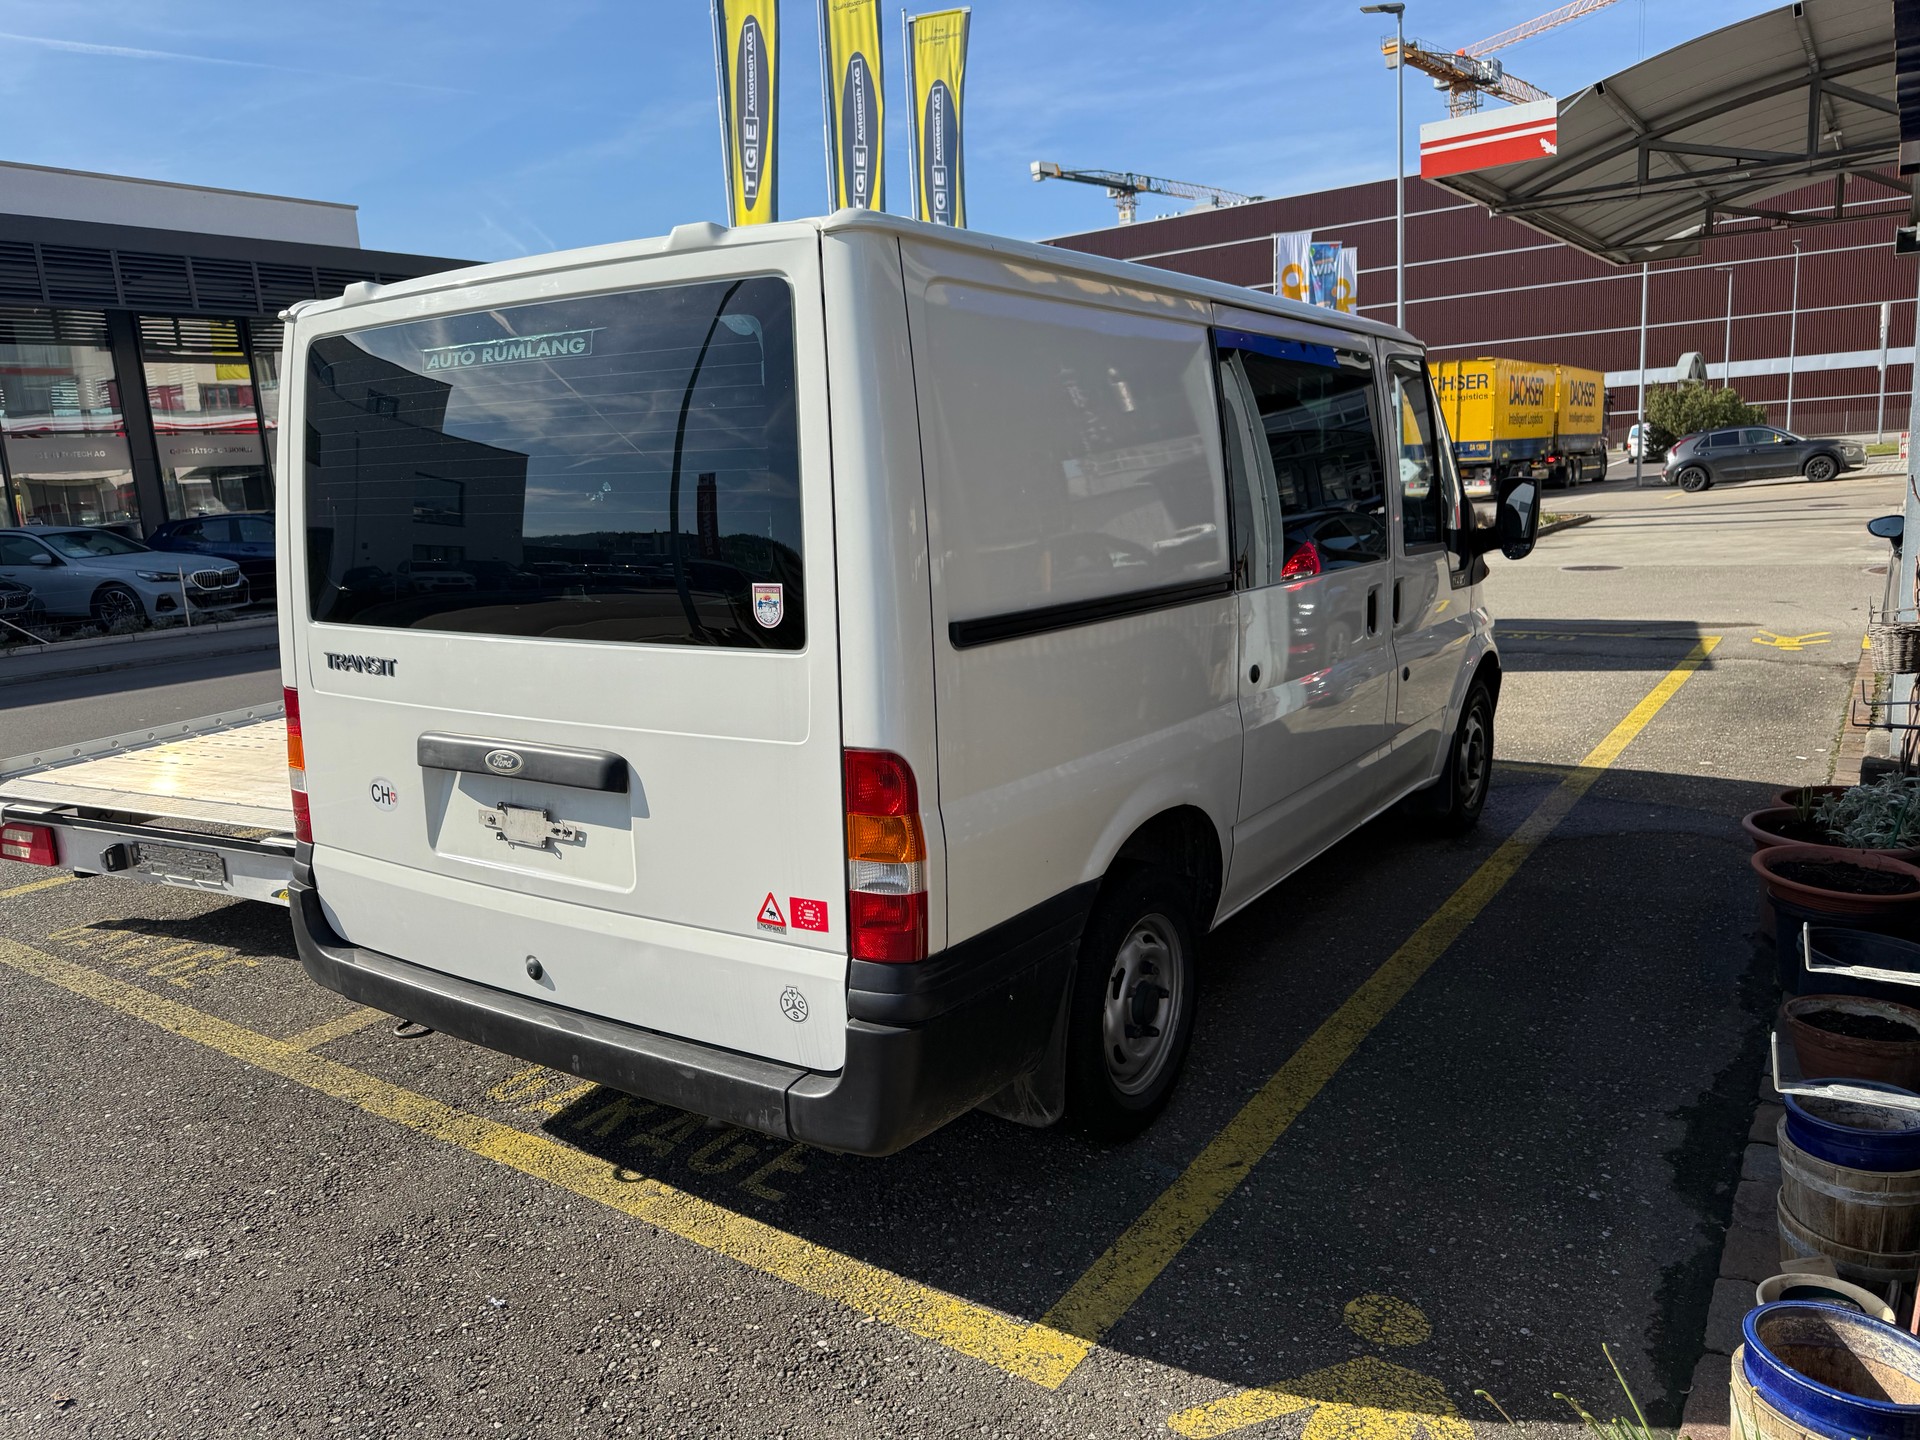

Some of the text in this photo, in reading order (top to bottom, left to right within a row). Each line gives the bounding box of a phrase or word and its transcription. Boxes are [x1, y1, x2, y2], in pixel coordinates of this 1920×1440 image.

[746, 31, 754, 52] AG
[854, 67, 862, 86] AG
[855, 88, 864, 141] Autotech
[934, 93, 941, 110] AG
[934, 112, 942, 162] Autotech
[745, 123, 757, 192] TGE
[1509, 374, 1544, 406] DACHSER
[1569, 379, 1596, 407] DACHSER
[323, 651, 399, 678] TRANSIT
[492, 753, 514, 768] Ford
[371, 783, 391, 806] CH
